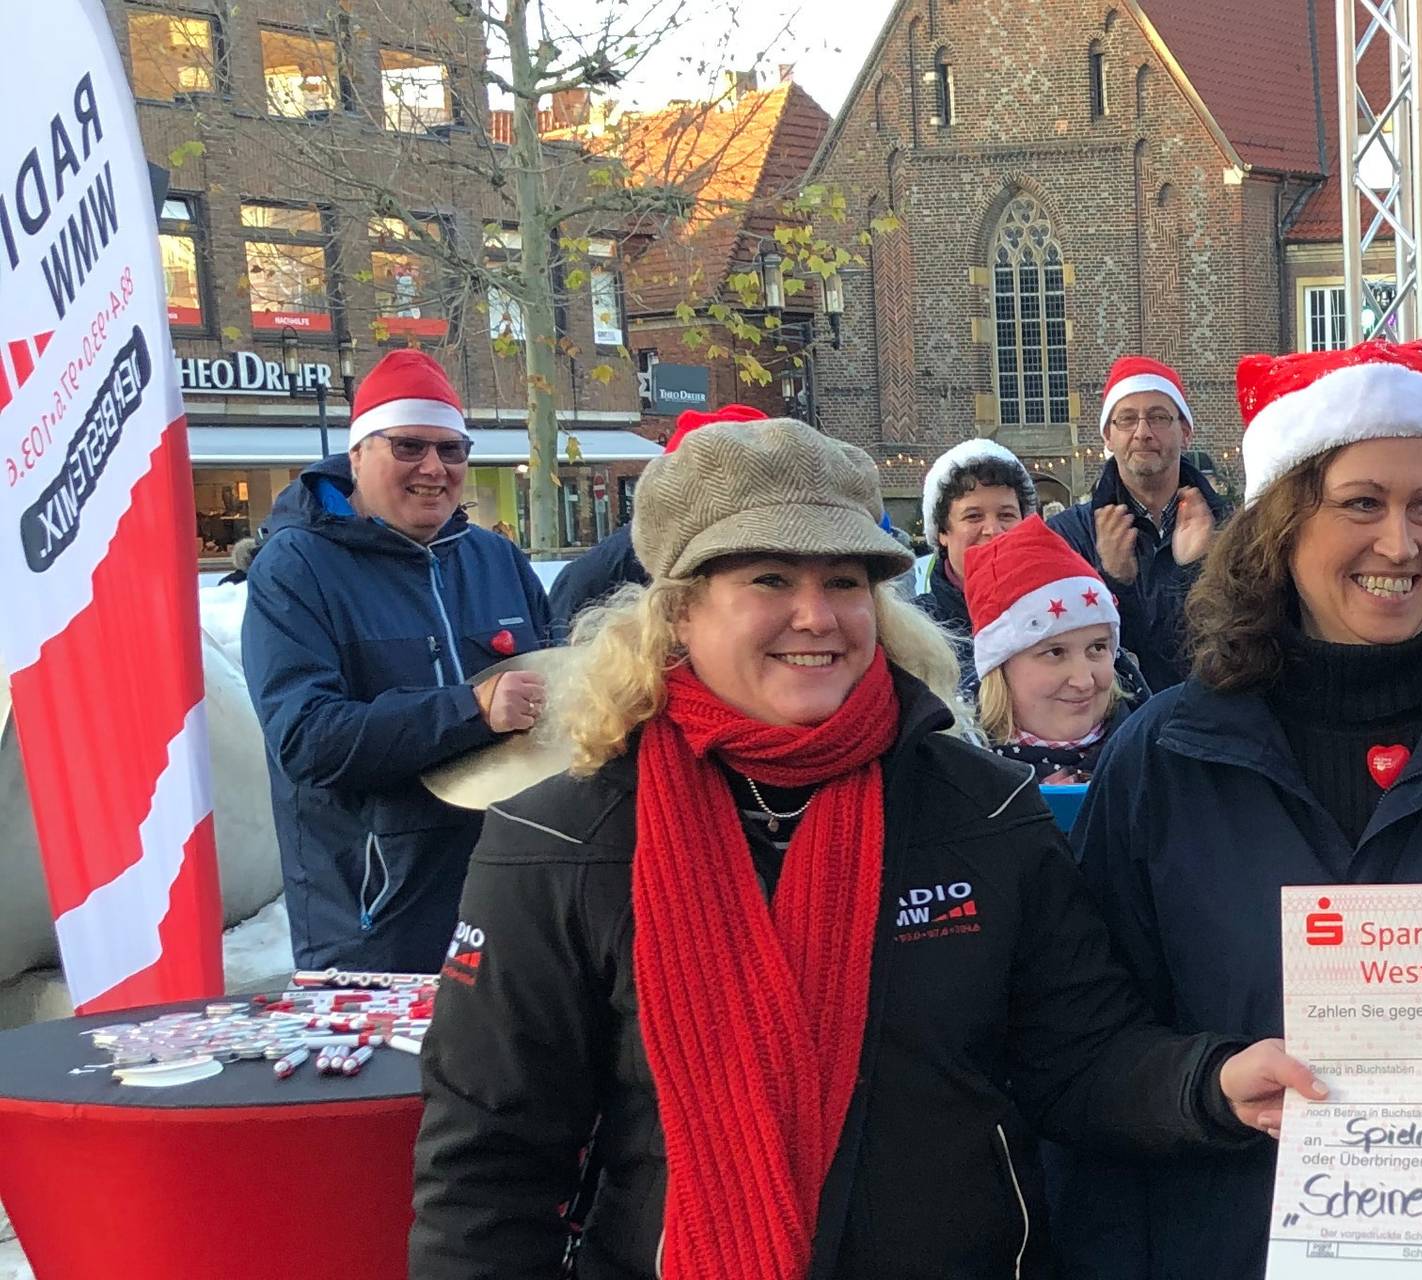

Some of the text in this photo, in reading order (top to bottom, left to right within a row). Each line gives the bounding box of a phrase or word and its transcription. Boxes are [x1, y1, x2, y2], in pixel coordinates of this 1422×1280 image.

[174, 357, 234, 389] HEO
[898, 882, 972, 907] DIO
[1307, 1005, 1357, 1018] Zahlen
[1361, 1004, 1384, 1018] Sie
[1309, 1064, 1415, 1076] Betrag in Buchstaben
[1306, 1107, 1331, 1118] noch
[1334, 1107, 1367, 1120] Betrag
[1369, 1108, 1379, 1118] in
[1303, 1136, 1322, 1147] an
[1302, 1152, 1336, 1165] oder
